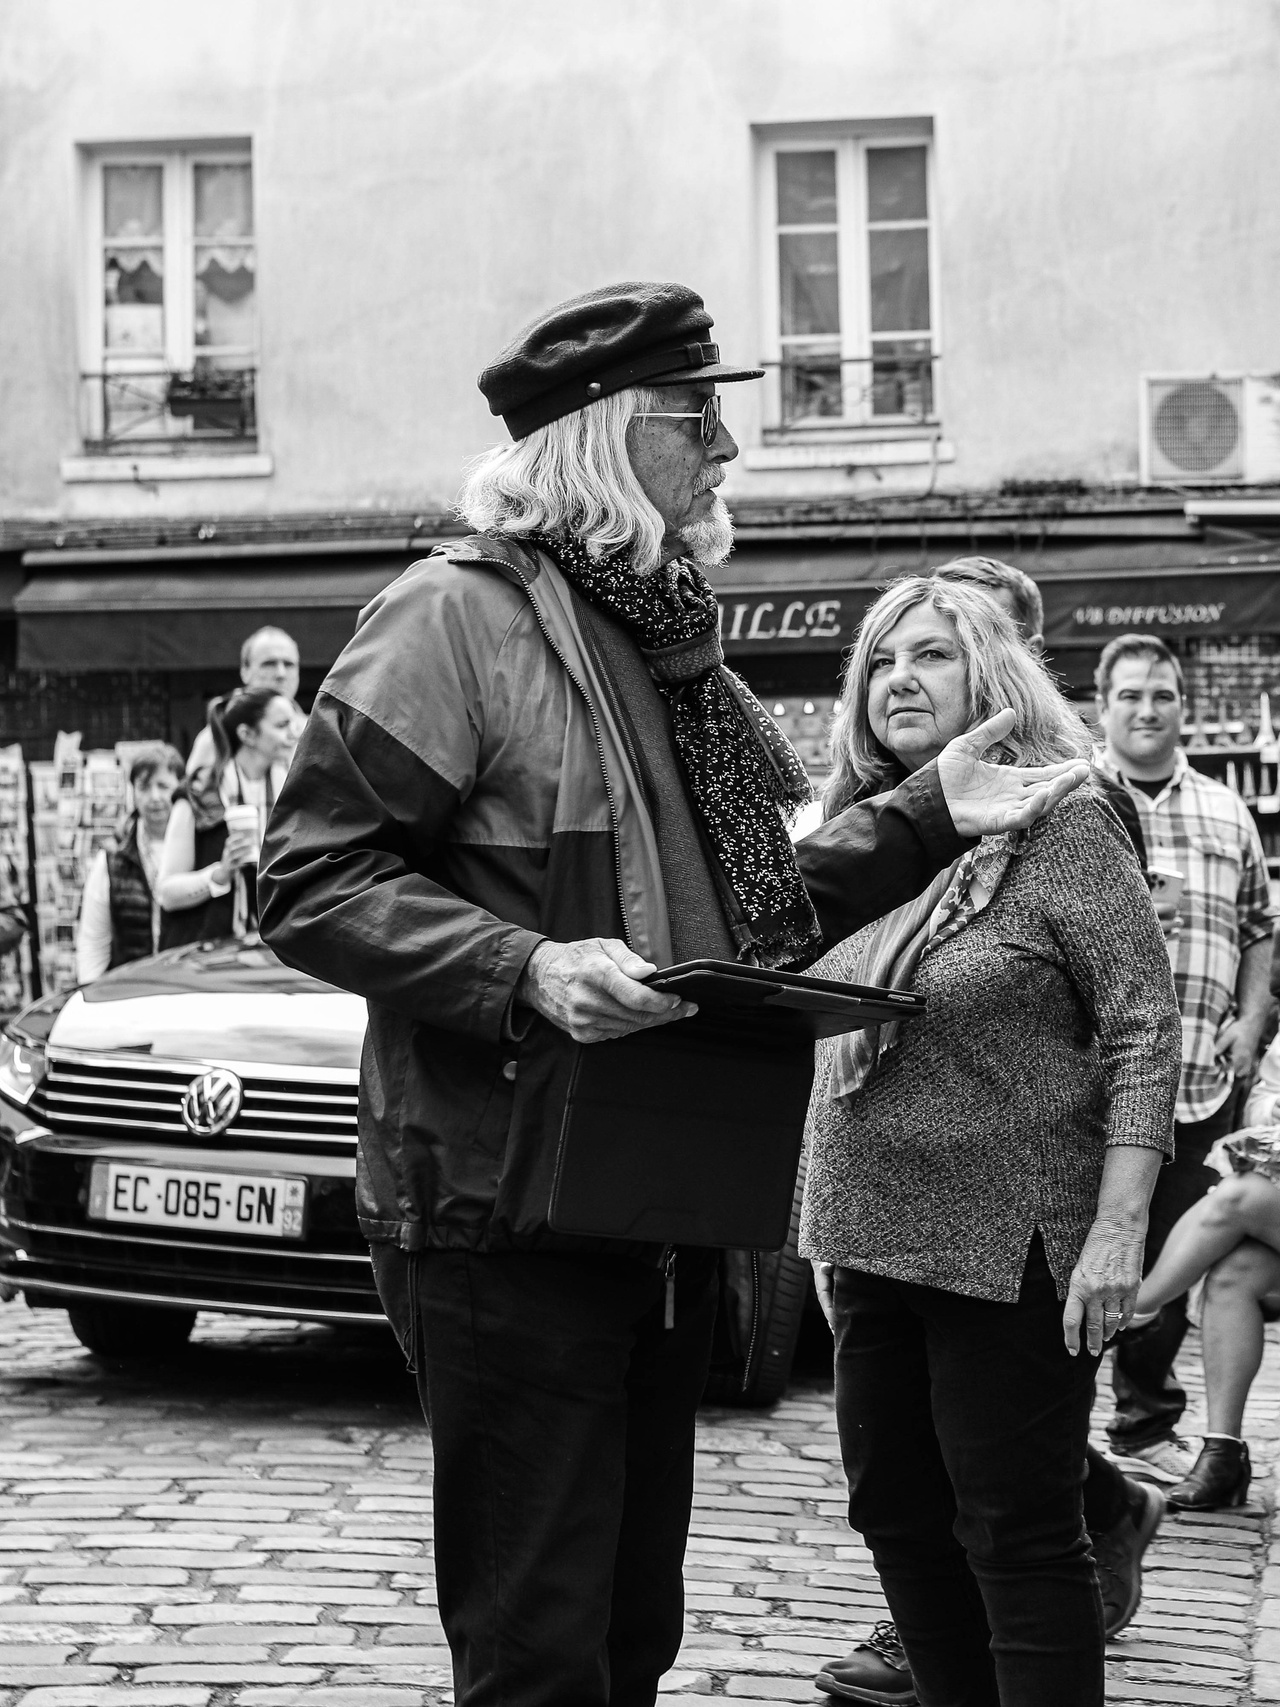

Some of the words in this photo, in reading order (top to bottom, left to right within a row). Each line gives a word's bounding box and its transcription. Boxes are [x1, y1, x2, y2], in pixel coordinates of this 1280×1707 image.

[718, 600, 841, 640] ILLE
[1105, 602, 1226, 625] DIFFUSION
[284, 1208, 302, 1231] 92
